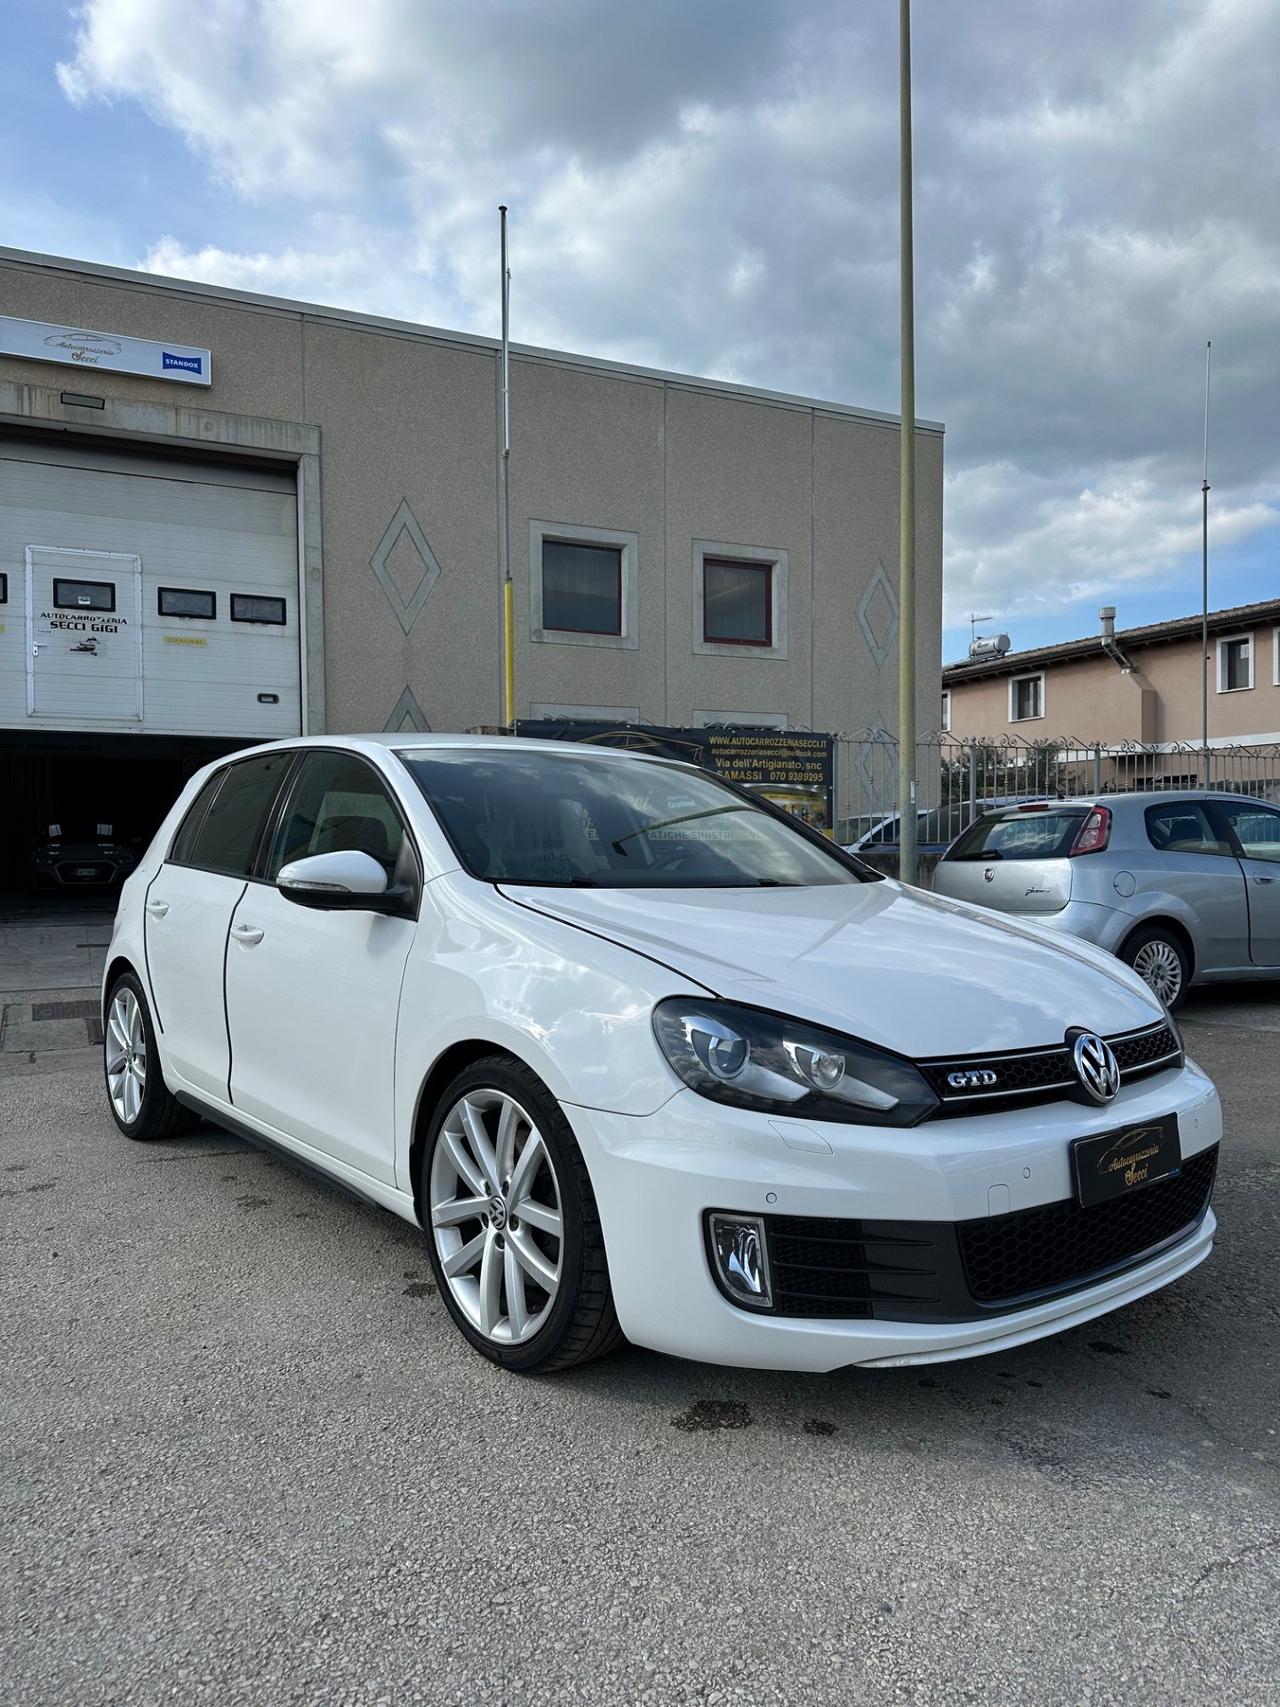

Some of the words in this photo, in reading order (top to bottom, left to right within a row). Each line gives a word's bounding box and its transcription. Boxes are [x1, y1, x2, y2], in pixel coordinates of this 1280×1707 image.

[165, 358, 199, 369] STANDOX
[50, 620, 86, 631] SECCI
[91, 623, 118, 633] GIGI
[709, 736, 827, 748] WWW.AUTOCARROZZERIASECCI.IT
[711, 748, 827, 758] autocarrozzeriasecci@outlook.com
[715, 758, 730, 768] Via
[806, 762, 822, 770] snc
[717, 771, 762, 780] SAMASSI
[770, 771, 786, 780] 070
[788, 772, 824, 782] 9389295
[947, 1069, 998, 1088] GTD
